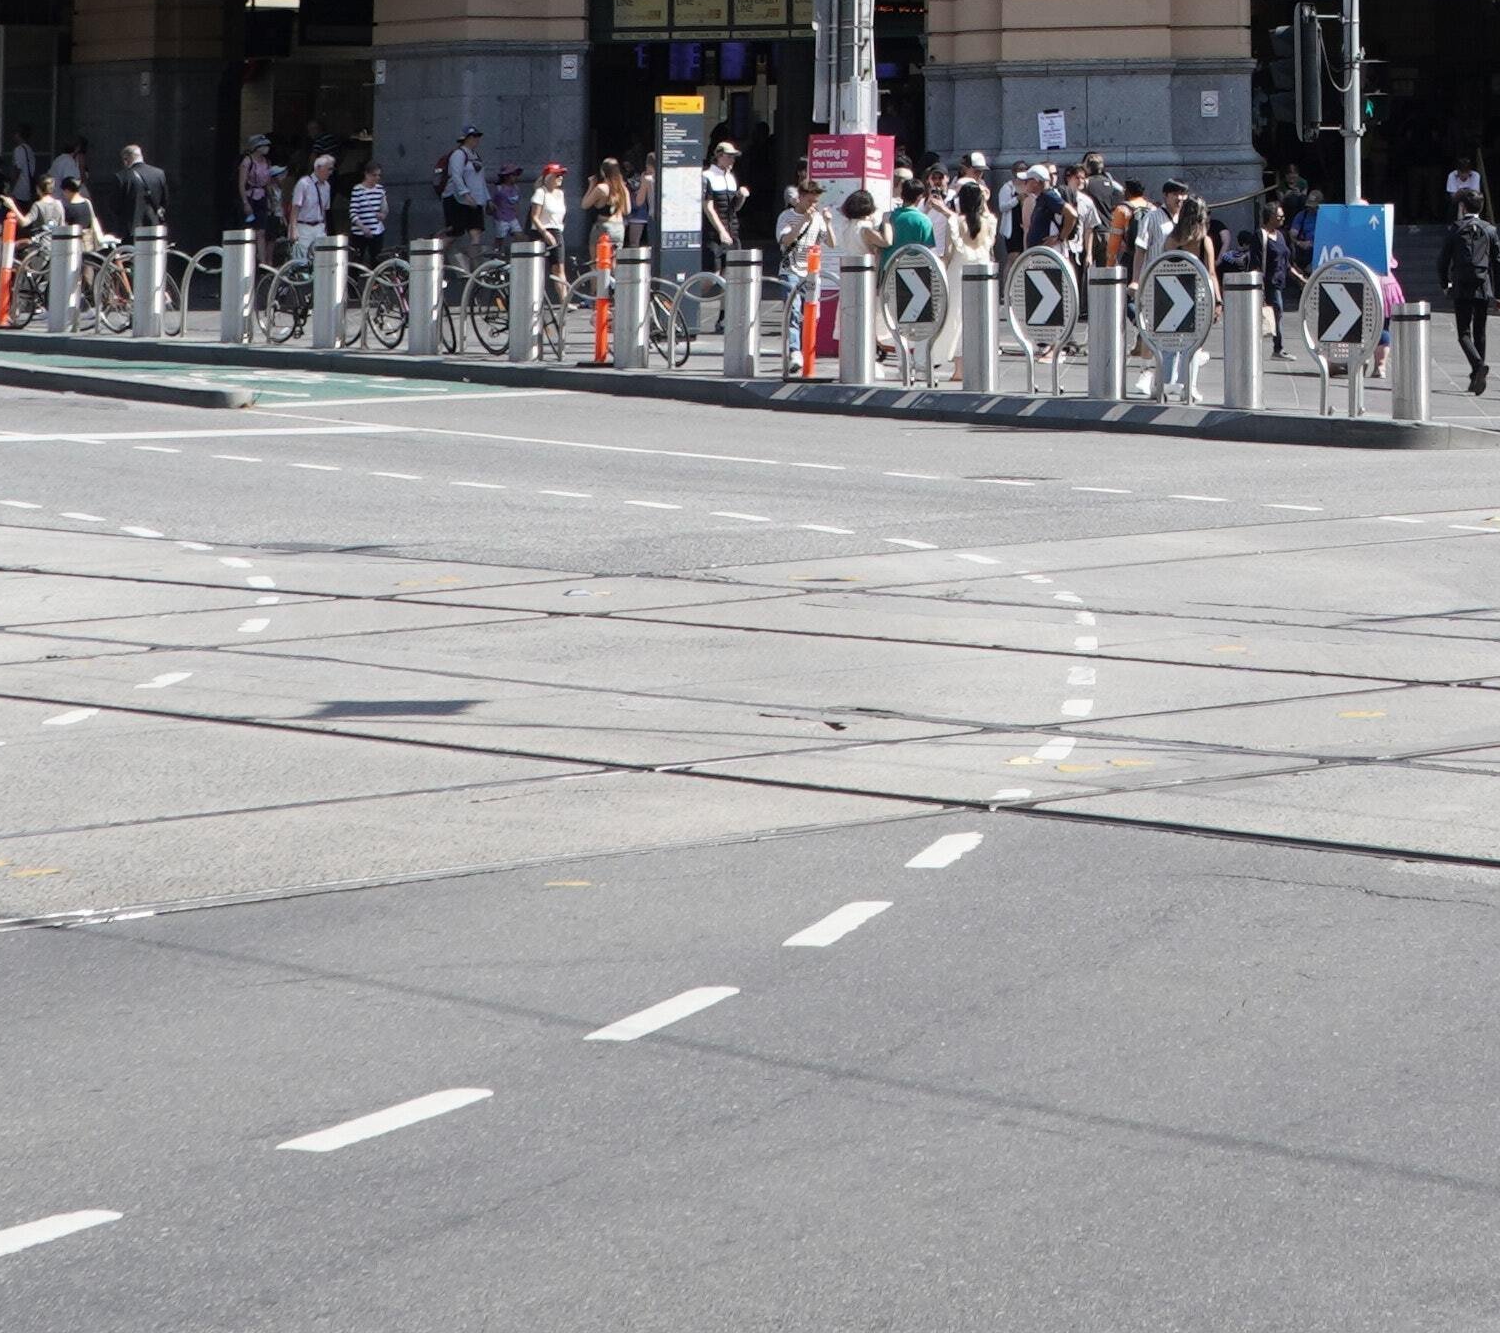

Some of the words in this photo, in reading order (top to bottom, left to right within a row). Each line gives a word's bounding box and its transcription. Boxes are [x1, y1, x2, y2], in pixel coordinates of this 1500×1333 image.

[812, 148, 840, 160] Getting
[841, 149, 849, 157] to
[812, 161, 825, 169] the
[827, 161, 848, 169] tennis
